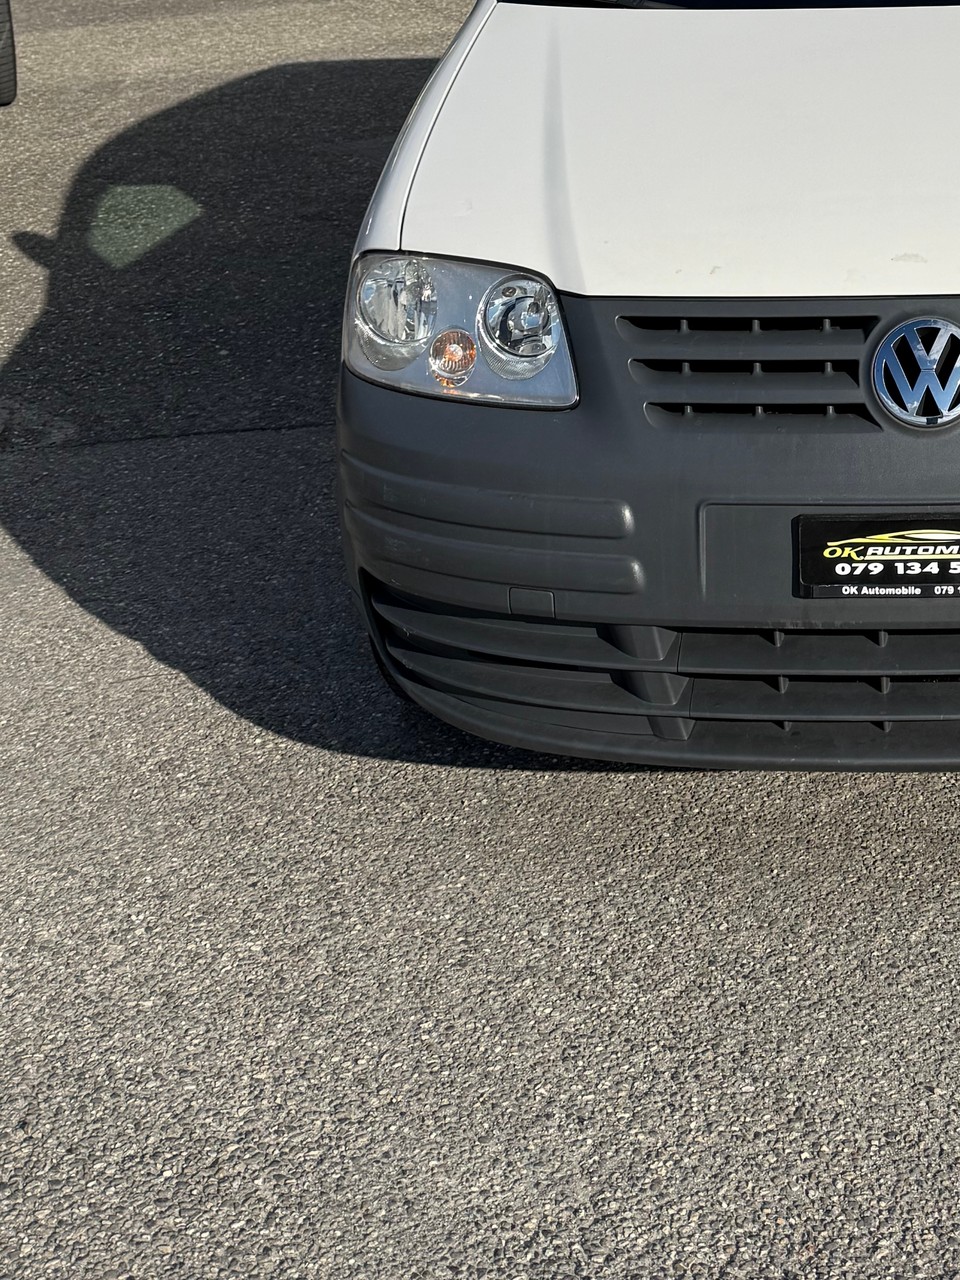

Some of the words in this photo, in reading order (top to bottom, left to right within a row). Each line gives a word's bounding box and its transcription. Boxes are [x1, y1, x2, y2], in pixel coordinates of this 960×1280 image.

[823, 546, 864, 560] OK
[835, 563, 884, 576] 079
[894, 561, 940, 575] 134
[842, 586, 859, 595] OK
[861, 586, 921, 595] Automobile
[934, 586, 954, 595] 079
